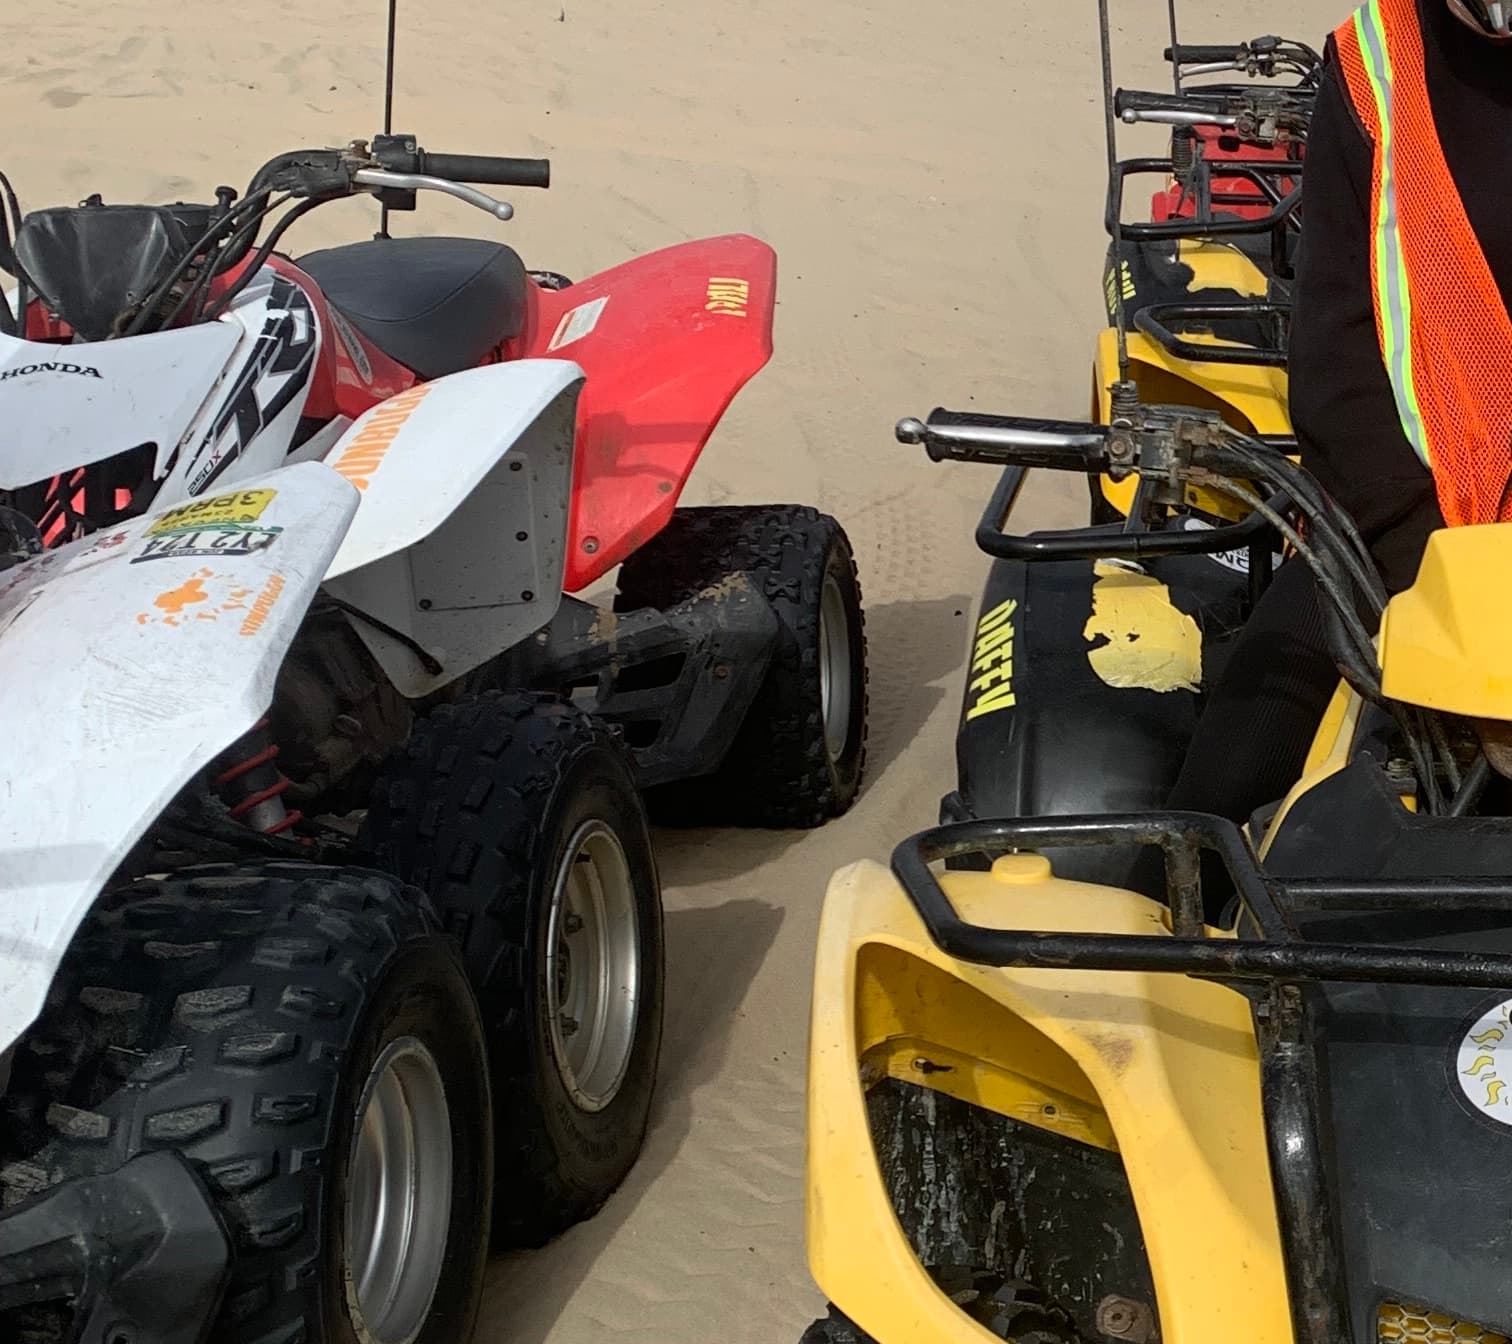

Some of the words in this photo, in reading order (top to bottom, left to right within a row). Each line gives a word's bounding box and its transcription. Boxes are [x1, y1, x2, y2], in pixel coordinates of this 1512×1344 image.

[0, 362, 104, 381] HONDA
[187, 450, 222, 497] 250X
[967, 599, 1017, 721] DAFFY
